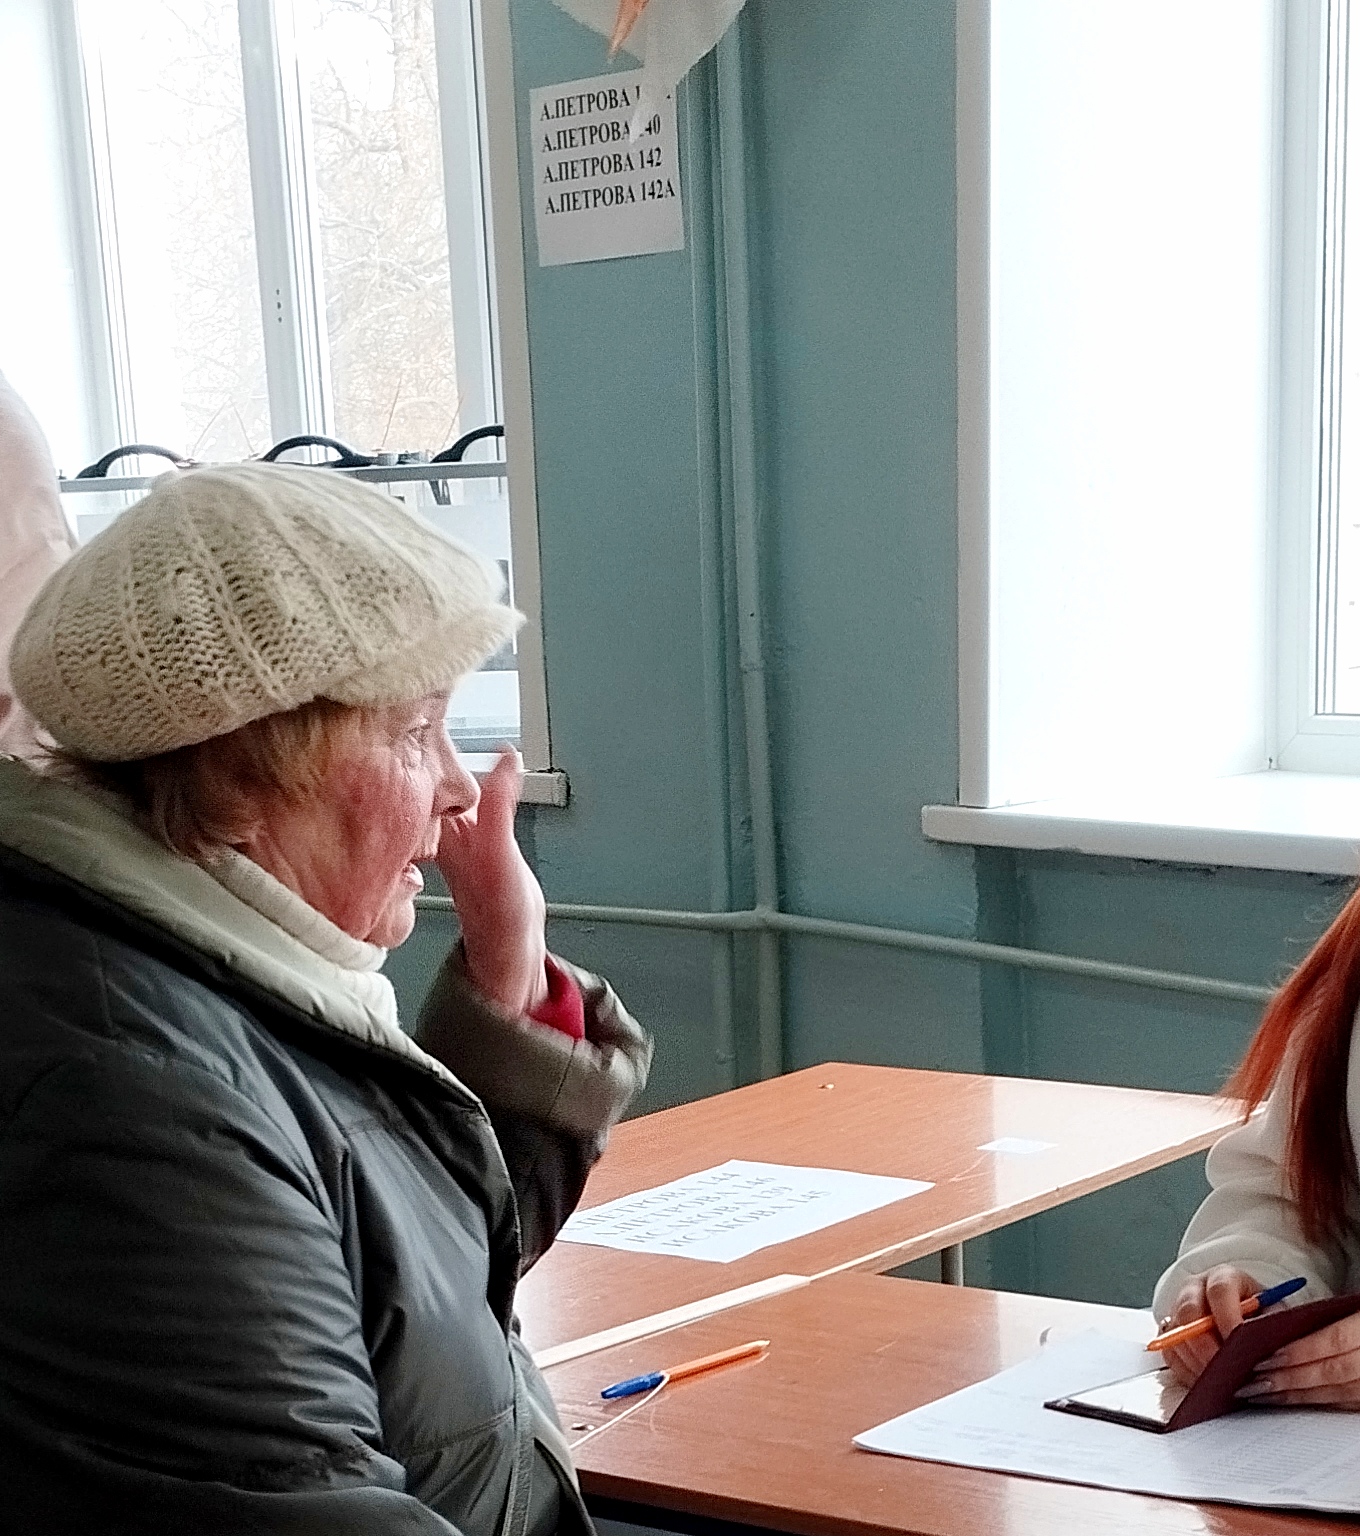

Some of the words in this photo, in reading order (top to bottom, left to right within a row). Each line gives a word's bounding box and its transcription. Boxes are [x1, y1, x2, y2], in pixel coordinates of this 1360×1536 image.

[540, 88, 630, 121] А.ПЕТРОВА
[542, 121, 630, 153] А.ПЕТРОВА
[639, 113, 661, 137] 40
[543, 153, 635, 184] А.ПЕТРОВА
[639, 146, 662, 169] 142
[544, 184, 636, 215] А.ПЕТРОВА
[641, 177, 676, 201] 142А
